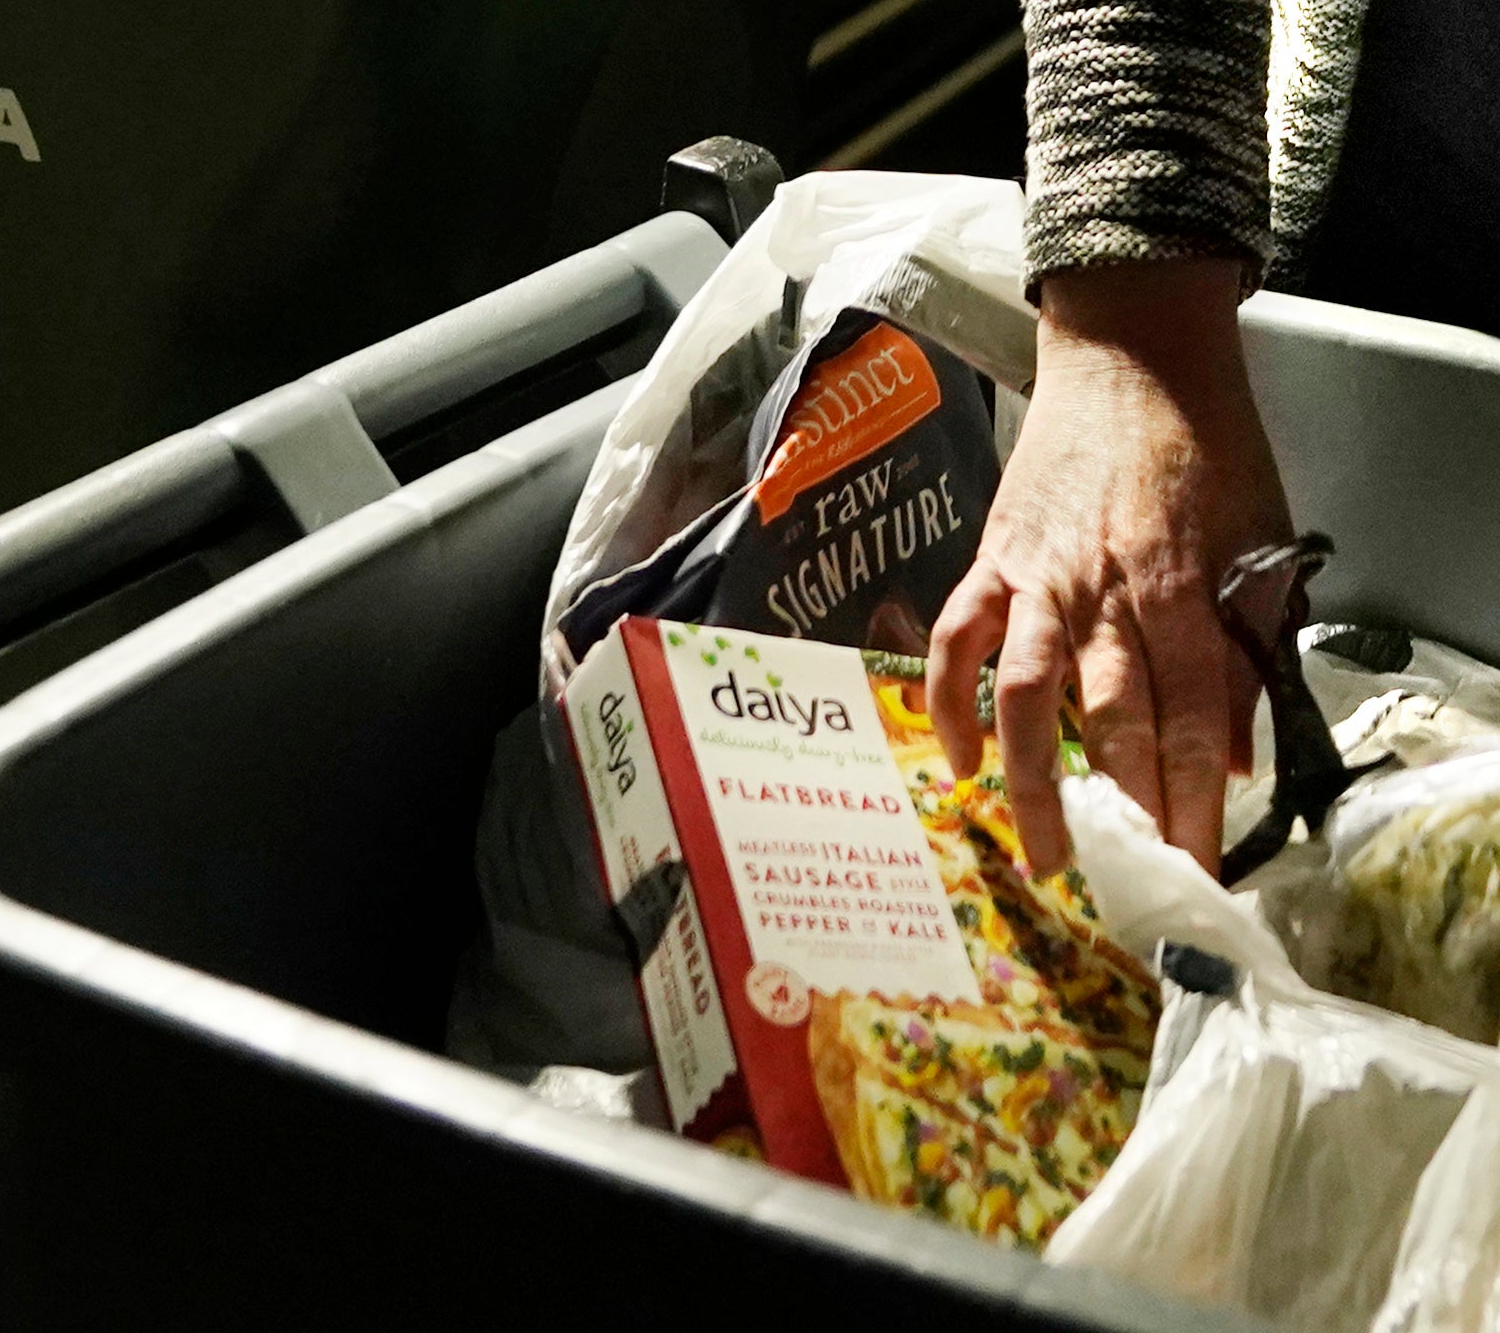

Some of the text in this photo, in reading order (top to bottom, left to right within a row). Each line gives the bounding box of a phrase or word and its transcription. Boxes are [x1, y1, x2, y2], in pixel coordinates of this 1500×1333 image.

[780, 345, 916, 465] stinct
[813, 457, 894, 538] raw
[766, 471, 963, 639] SIGNATURE
[710, 670, 855, 738] daiya
[599, 690, 637, 797] daiya
[718, 775, 902, 815] FLATBREAD
[738, 839, 924, 868] MEATLESS ITALIAN
[744, 861, 882, 892] SAUSAGE
[753, 889, 939, 917] CRUMBLES ROASTED
[760, 911, 852, 933] PEPPER
[889, 919, 948, 941] KALE
